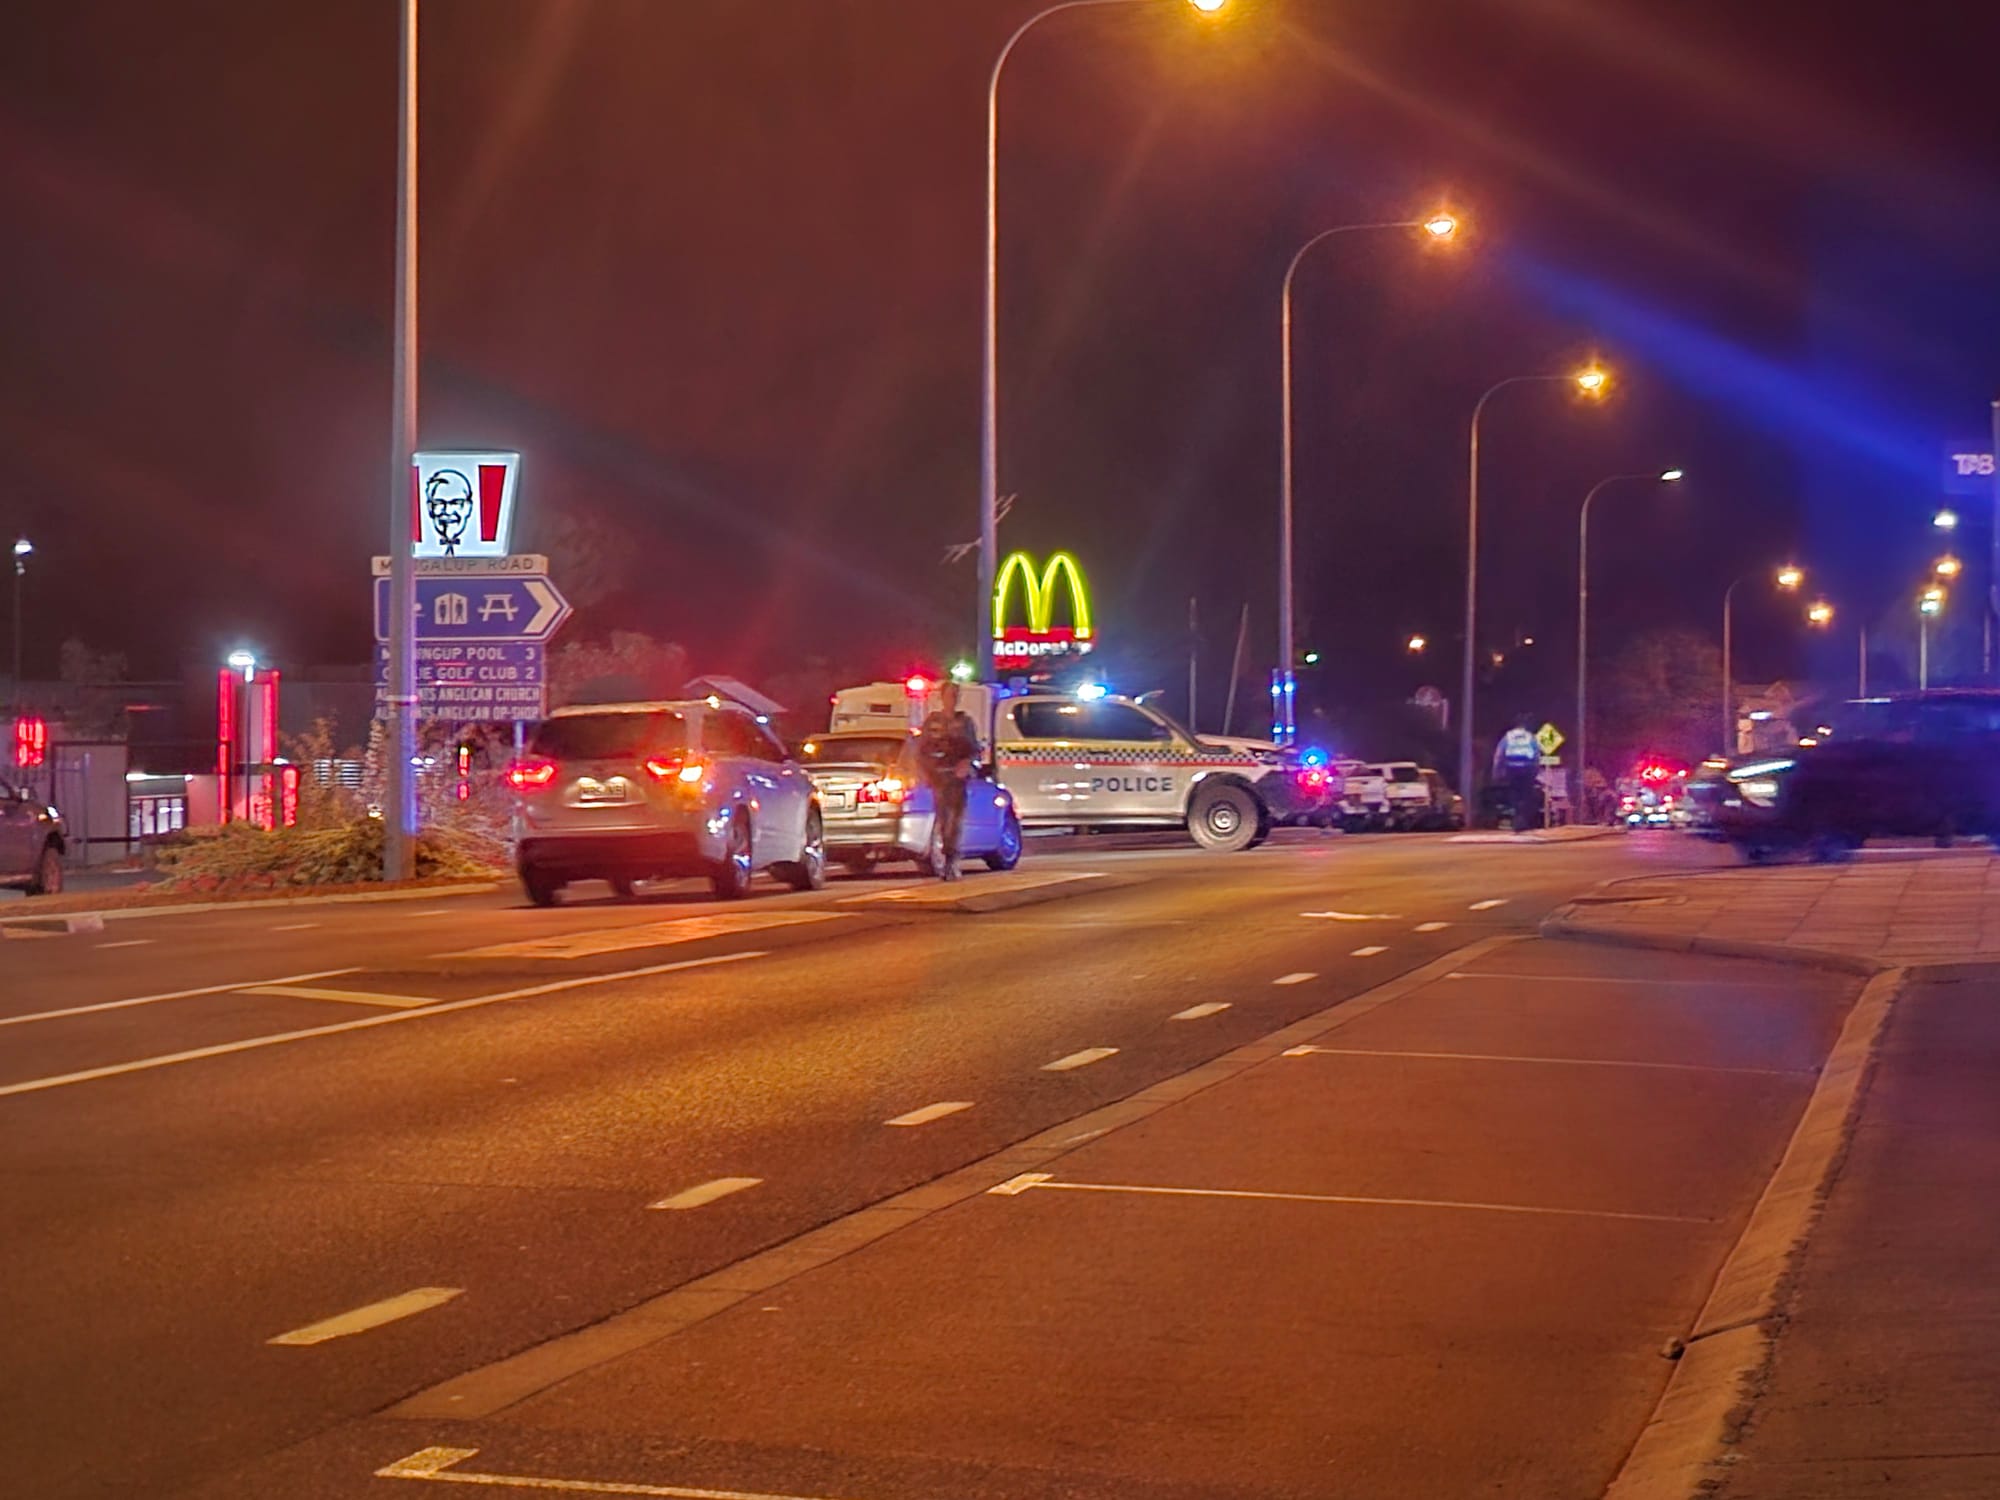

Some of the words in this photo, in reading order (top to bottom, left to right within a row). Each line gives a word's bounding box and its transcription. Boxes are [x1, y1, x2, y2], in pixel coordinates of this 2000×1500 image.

[487, 557, 533, 570] ROAD
[466, 648, 506, 660] POOL
[525, 647, 535, 660] 3
[437, 667, 475, 680] GOLF
[479, 667, 518, 680] CLUB
[525, 667, 535, 680] 2
[438, 687, 492, 701] ANGLICAN
[496, 687, 539, 701] CHURCH
[1091, 777, 1173, 792] POLICE
